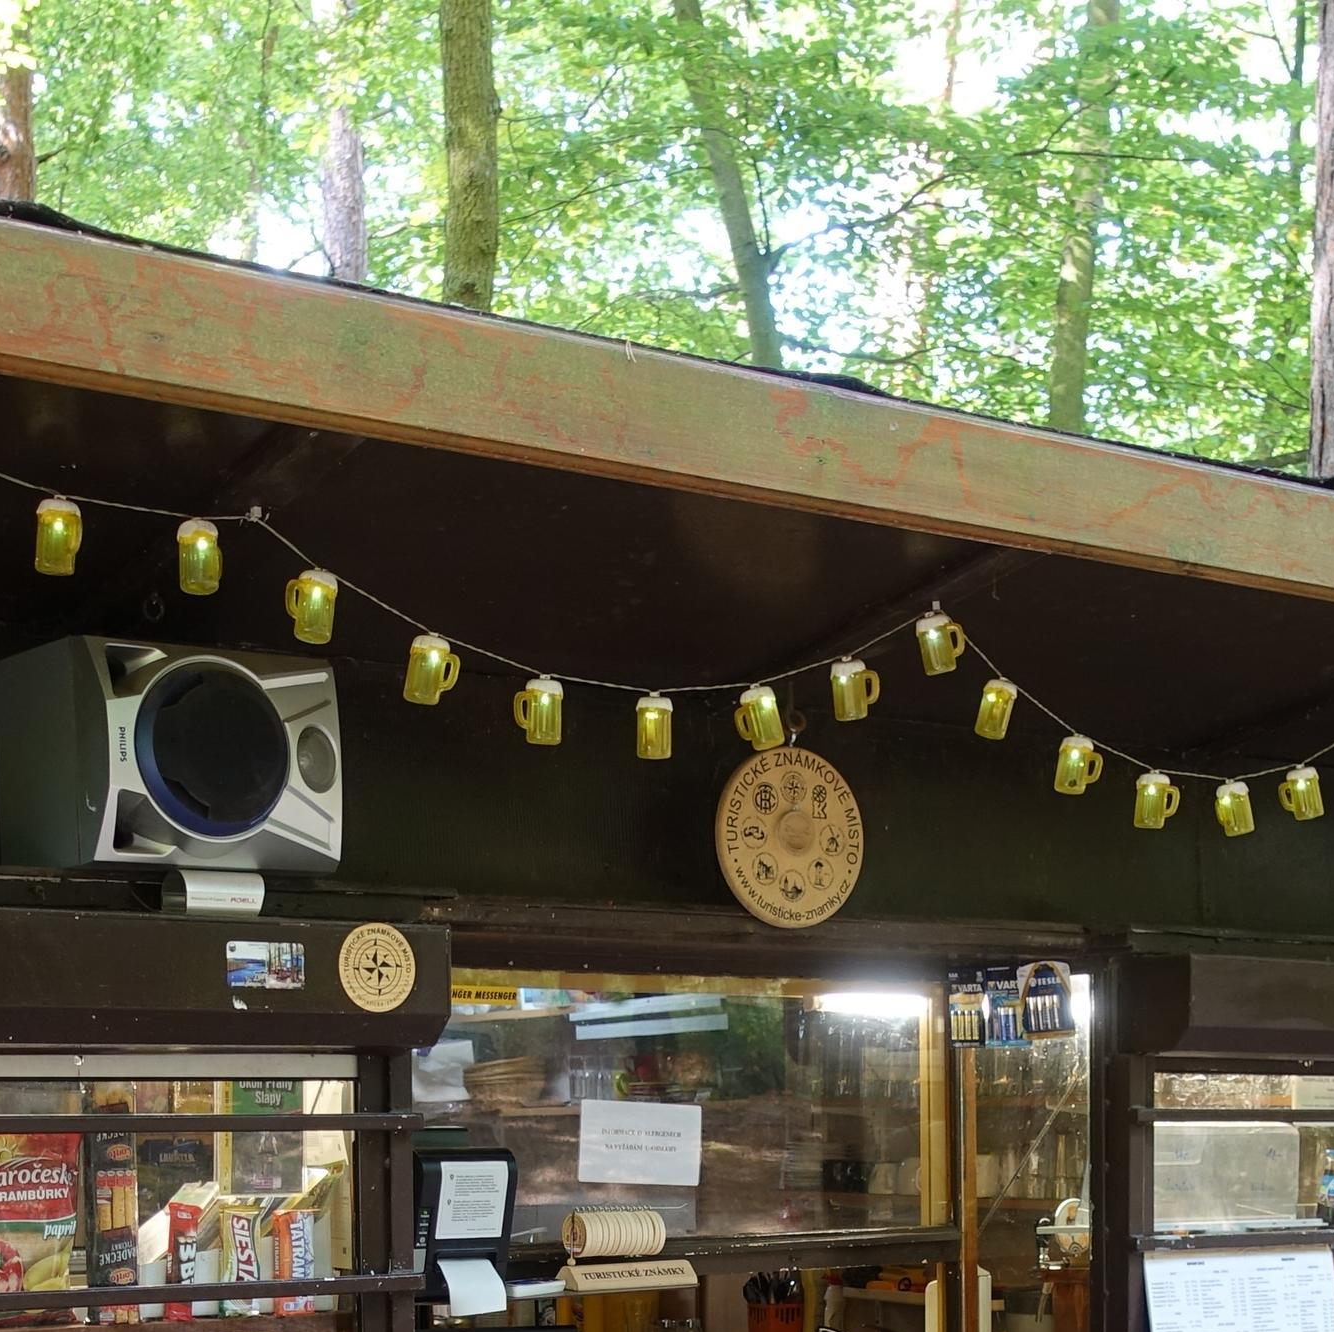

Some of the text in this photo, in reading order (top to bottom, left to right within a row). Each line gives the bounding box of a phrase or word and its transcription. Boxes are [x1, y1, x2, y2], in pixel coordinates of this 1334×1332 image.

[118, 726, 127, 762] PHILIPS
[727, 749, 860, 865] TURISTICKÉ ZNÁMKOVÉ MÍSTO
[736, 866, 851, 921] www.turisticke-znamky.cz
[957, 984, 983, 993] VARTA
[996, 980, 1020, 990] VART
[474, 990, 518, 1001] MESSENGER
[255, 1090, 282, 1105] Slapy
[43, 1220, 77, 1240] papri
[231, 1215, 261, 1282] SIESTA
[290, 1219, 305, 1280] TATRAN
[581, 1266, 686, 1281] TURISTICKÉ ZNÁMKY
